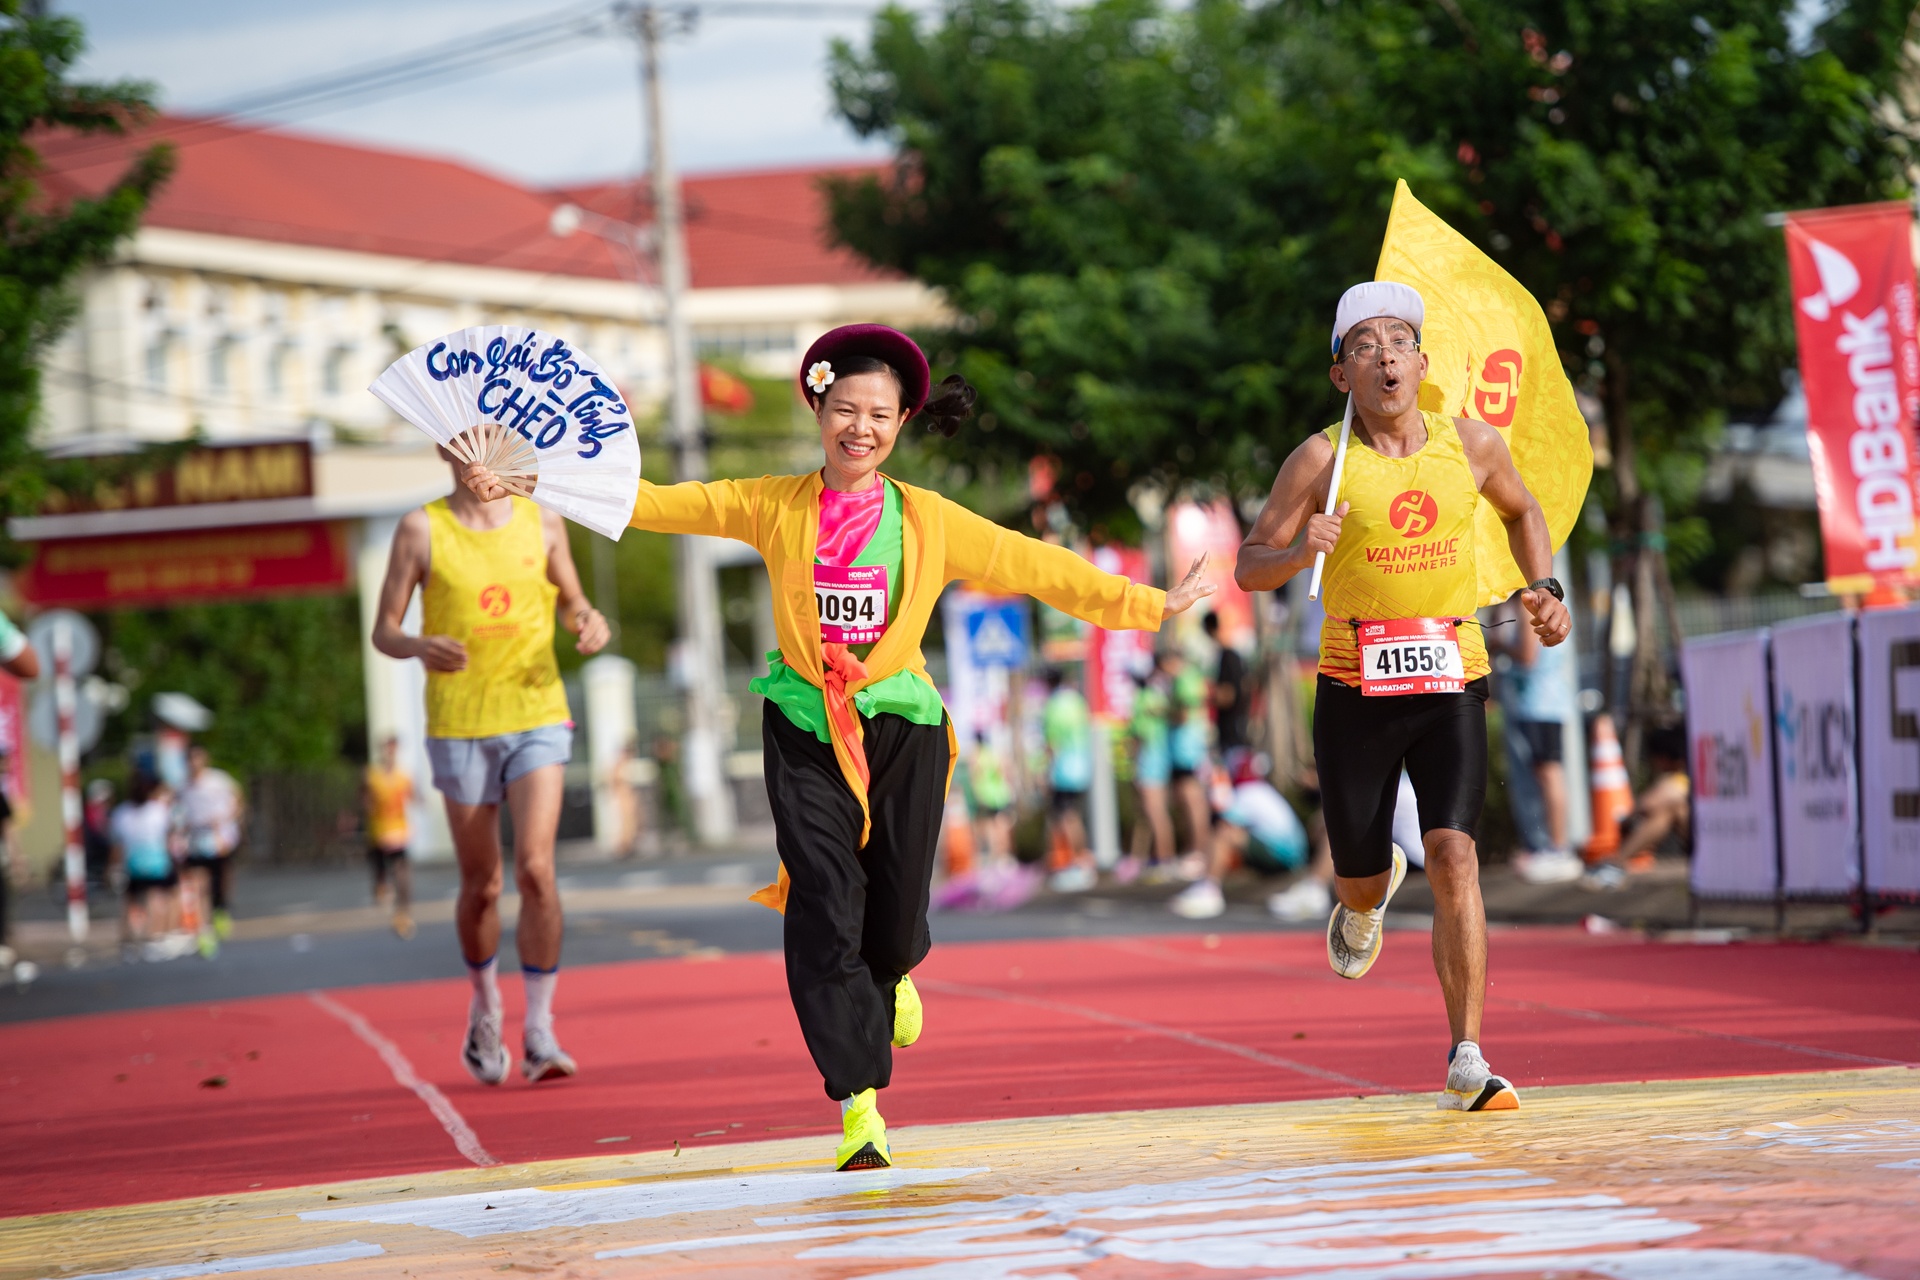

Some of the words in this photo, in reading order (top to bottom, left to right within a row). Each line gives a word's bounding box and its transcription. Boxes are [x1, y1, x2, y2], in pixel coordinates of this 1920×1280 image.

[426, 341, 484, 382] Con
[477, 377, 568, 450] CHÈO
[1835, 304, 1917, 571] HDBank
[1365, 537, 1459, 563] VANPHUC
[1375, 555, 1457, 575] RUNNERS
[1376, 646, 1448, 675] 41558
[1369, 683, 1414, 692] MARATHON
